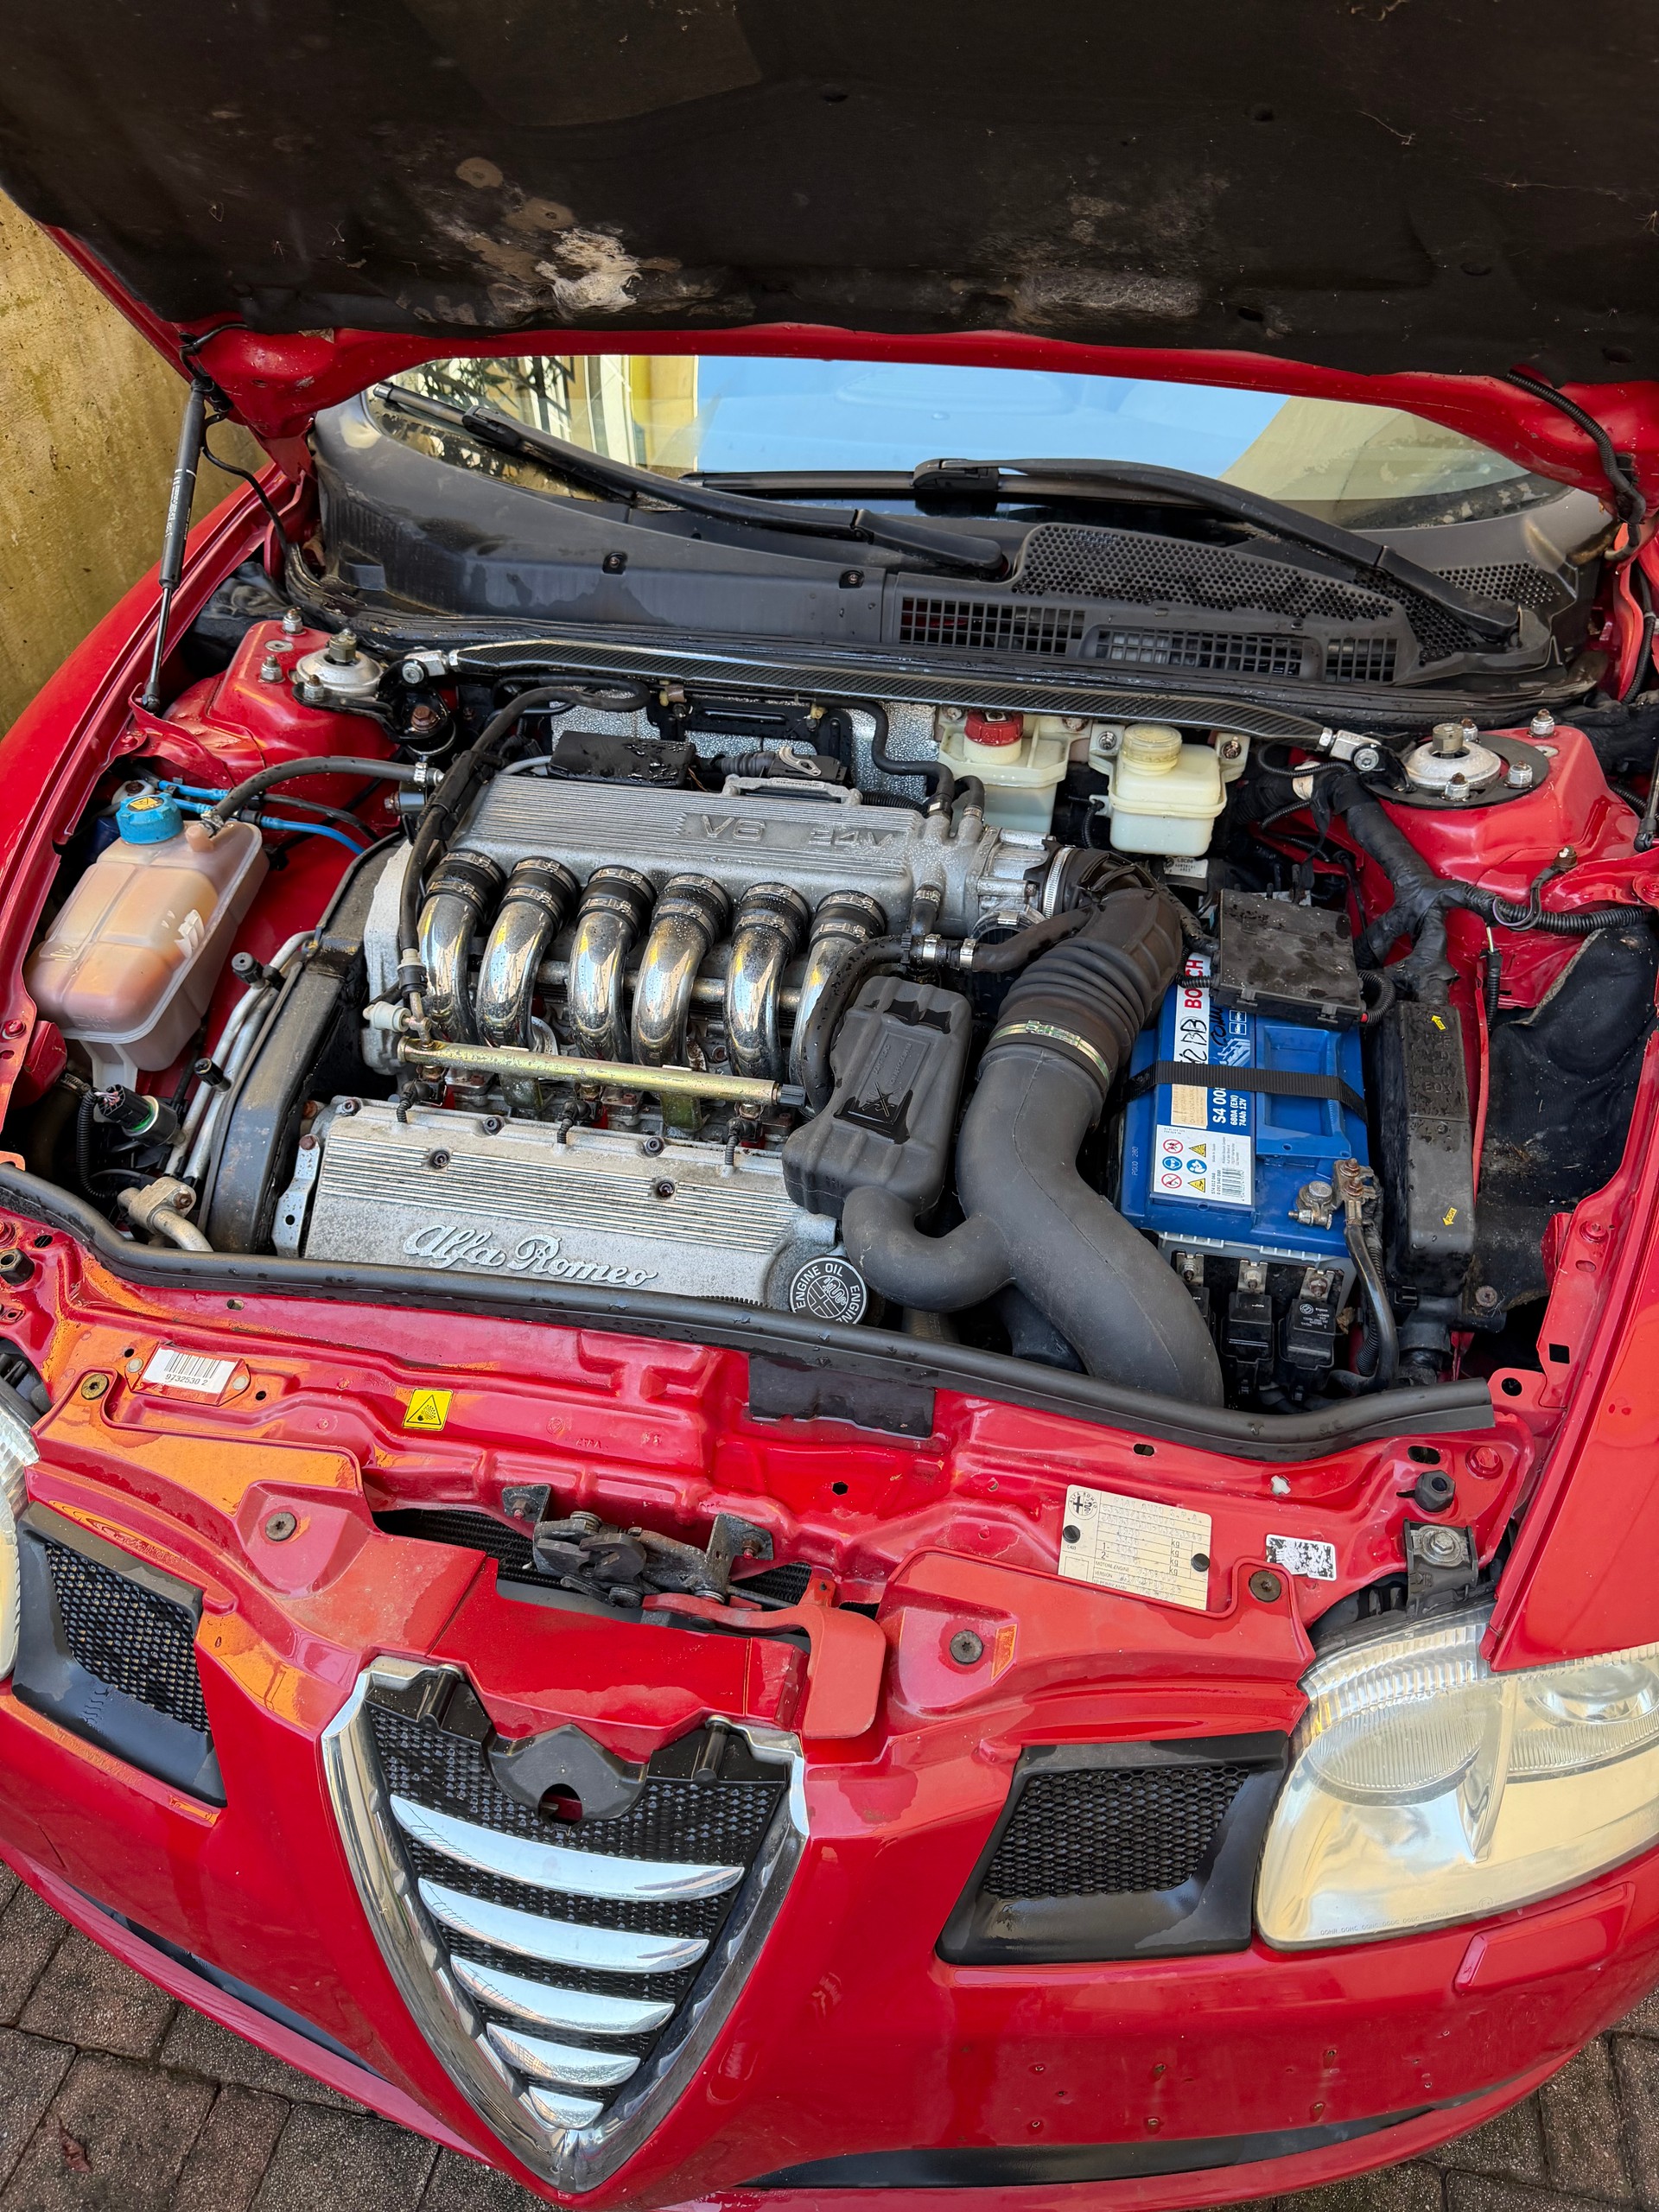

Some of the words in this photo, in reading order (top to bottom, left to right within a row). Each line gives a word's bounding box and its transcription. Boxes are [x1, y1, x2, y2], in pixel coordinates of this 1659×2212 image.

[702, 815, 766, 841] V6
[1184, 959, 1204, 1009] BOCH
[1230, 1095, 1239, 1109] (EN)
[1212, 1108, 1227, 1124] S4
[403, 1224, 507, 1269] Alfa
[507, 1234, 659, 1287] Romeo
[795, 1265, 822, 1310] ENGINE
[825, 1262, 843, 1277] OIL
[165, 1373, 201, 1385] 9732530
[1171, 1540, 1180, 1548] kg
[1170, 1548, 1179, 1557] kg
[1169, 1557, 1179, 1567] kg
[1168, 1566, 1178, 1576] kg
